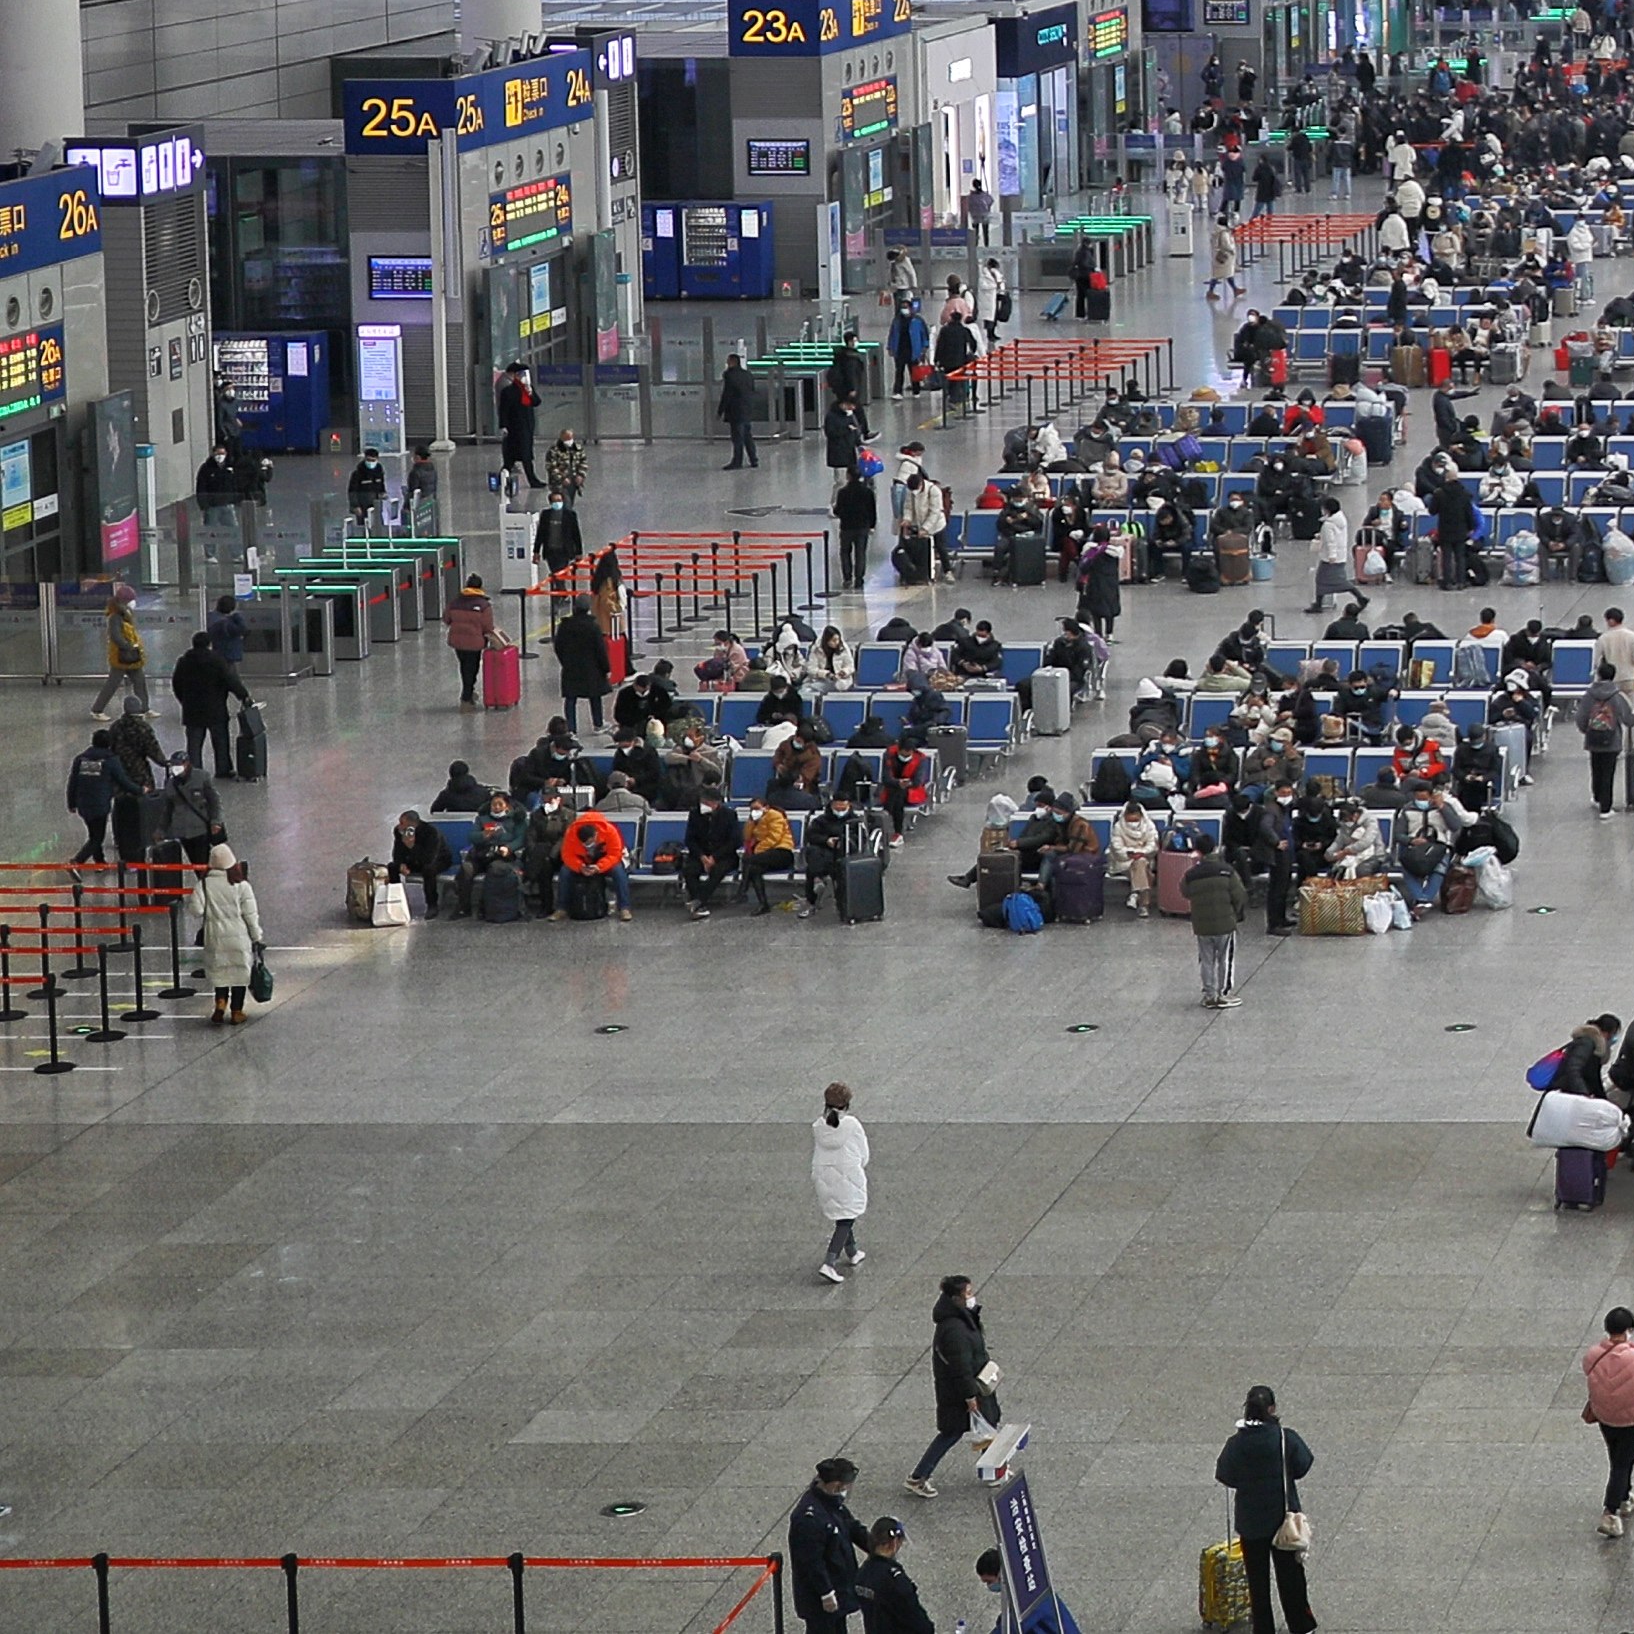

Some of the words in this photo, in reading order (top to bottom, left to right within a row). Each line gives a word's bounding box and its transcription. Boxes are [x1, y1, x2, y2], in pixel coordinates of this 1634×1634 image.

[742, 10, 805, 43] 23A
[819, 8, 839, 42] 23A
[522, 77, 548, 104] 检票口
[566, 68, 592, 107] 24A
[361, 98, 438, 137] 25A
[456, 95, 484, 136] 25A
[59, 189, 98, 239] 26A
[40, 338, 62, 367] 26A
